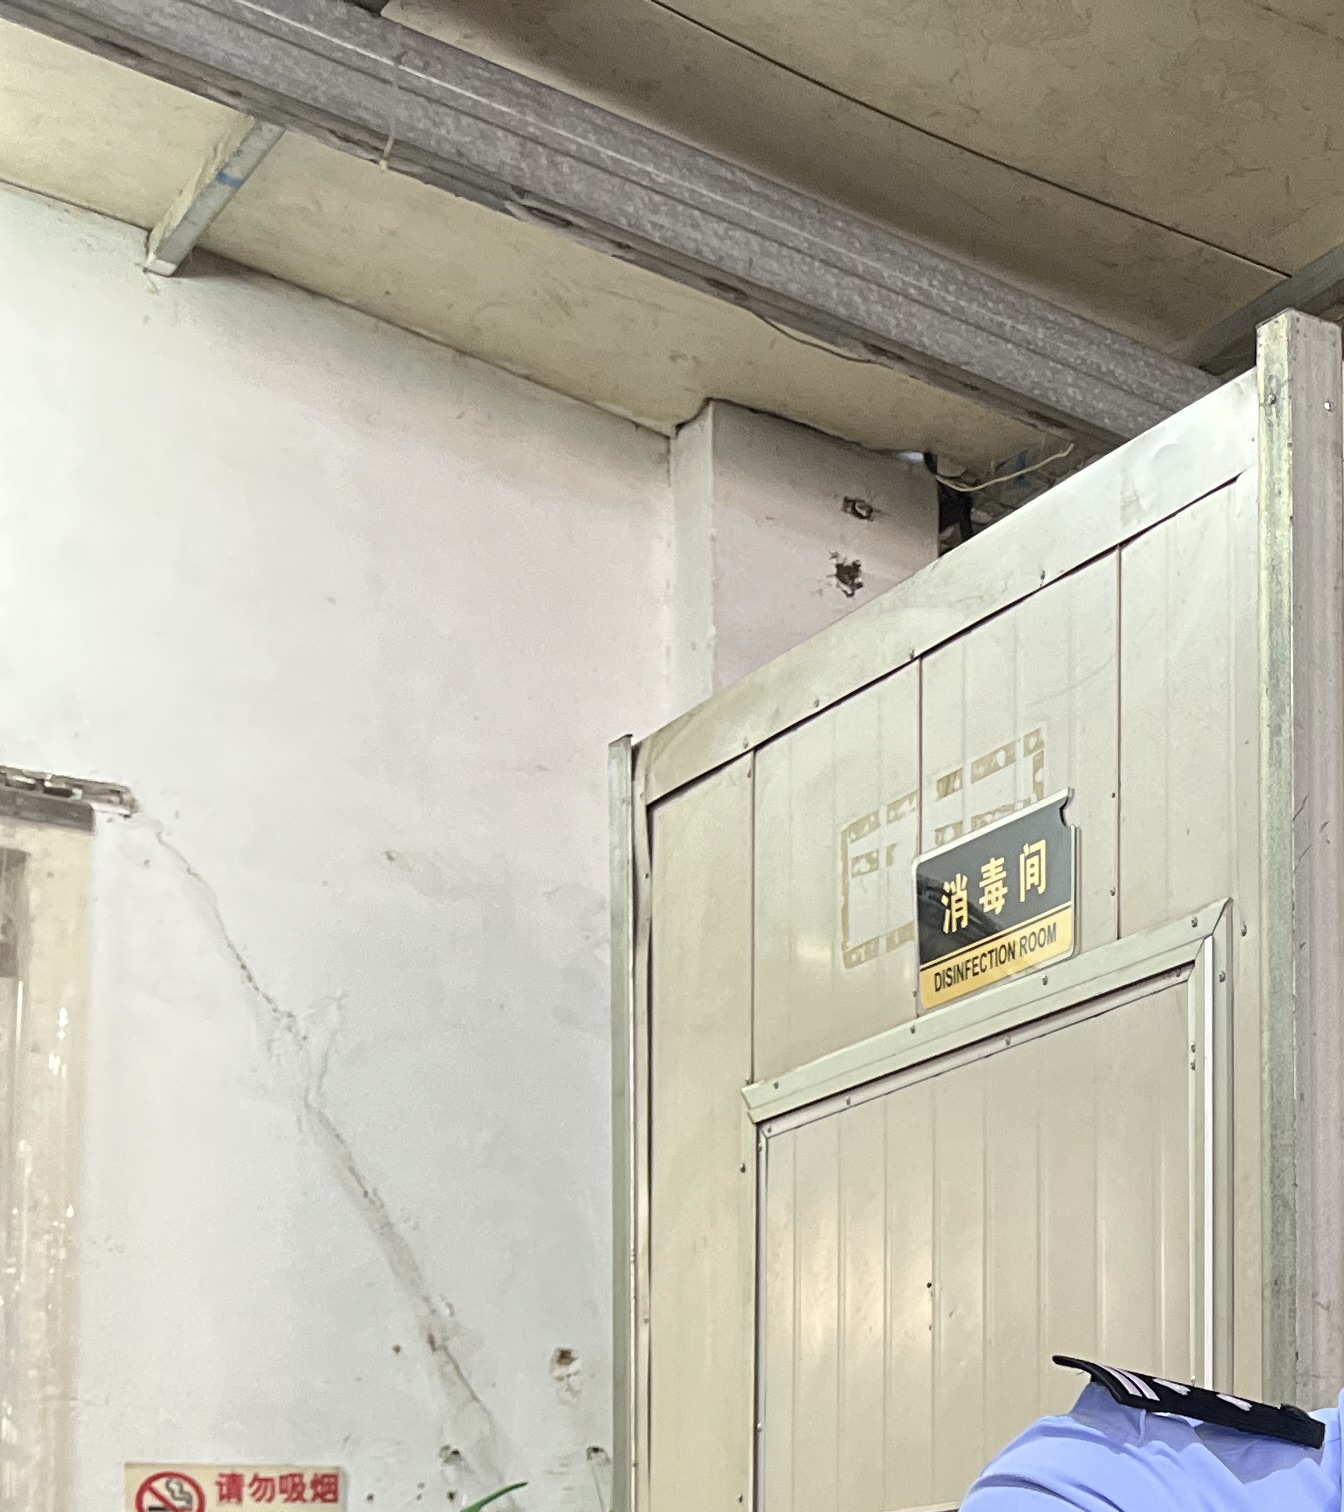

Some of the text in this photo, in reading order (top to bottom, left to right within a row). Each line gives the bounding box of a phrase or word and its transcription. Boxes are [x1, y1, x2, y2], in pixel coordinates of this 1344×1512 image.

[941, 839, 1047, 934] 消毒间
[934, 922, 1057, 993] DISINFECTION ROOM
[215, 1471, 340, 1504] 请勿吸烟
